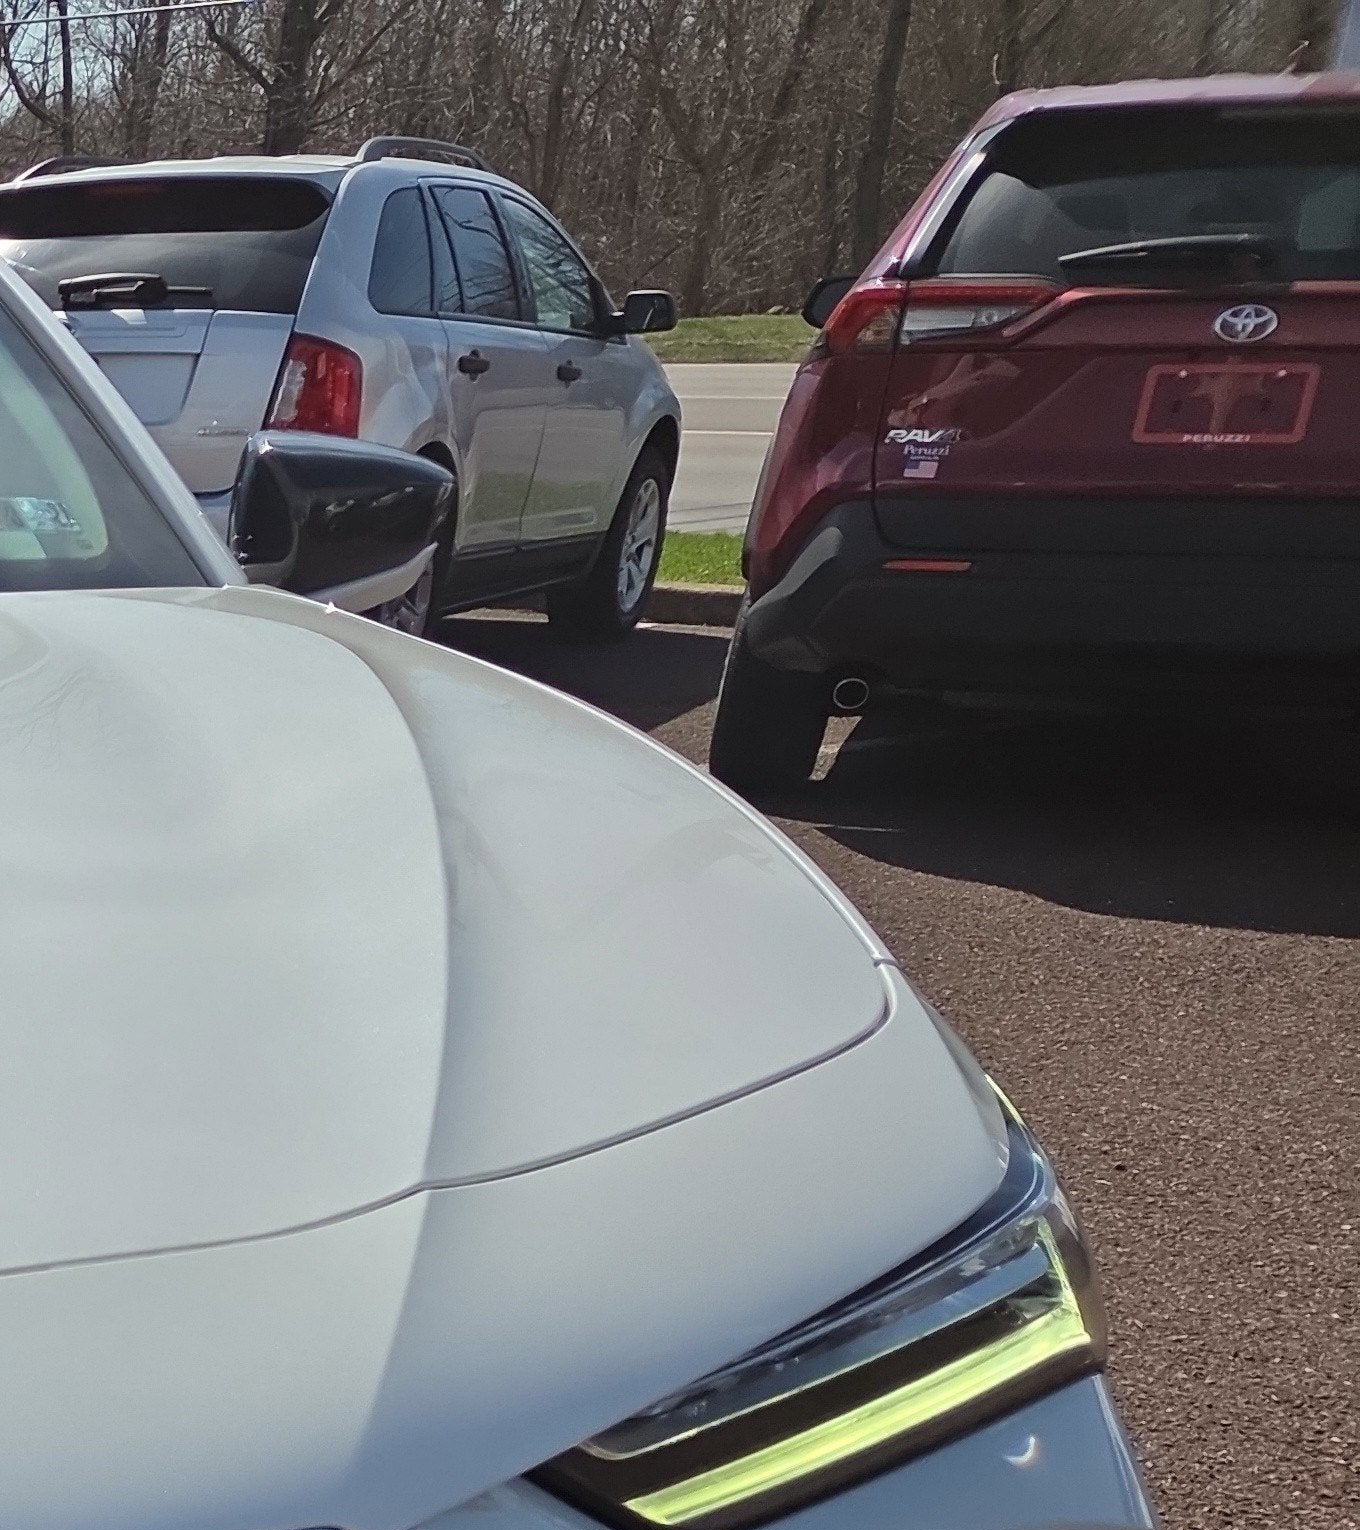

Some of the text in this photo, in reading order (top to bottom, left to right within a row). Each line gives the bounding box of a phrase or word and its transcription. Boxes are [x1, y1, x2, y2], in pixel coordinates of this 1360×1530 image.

[884, 430, 962, 443] RAV4
[1182, 433, 1252, 442] PERUZZI
[903, 444, 950, 456] Peruzzi
